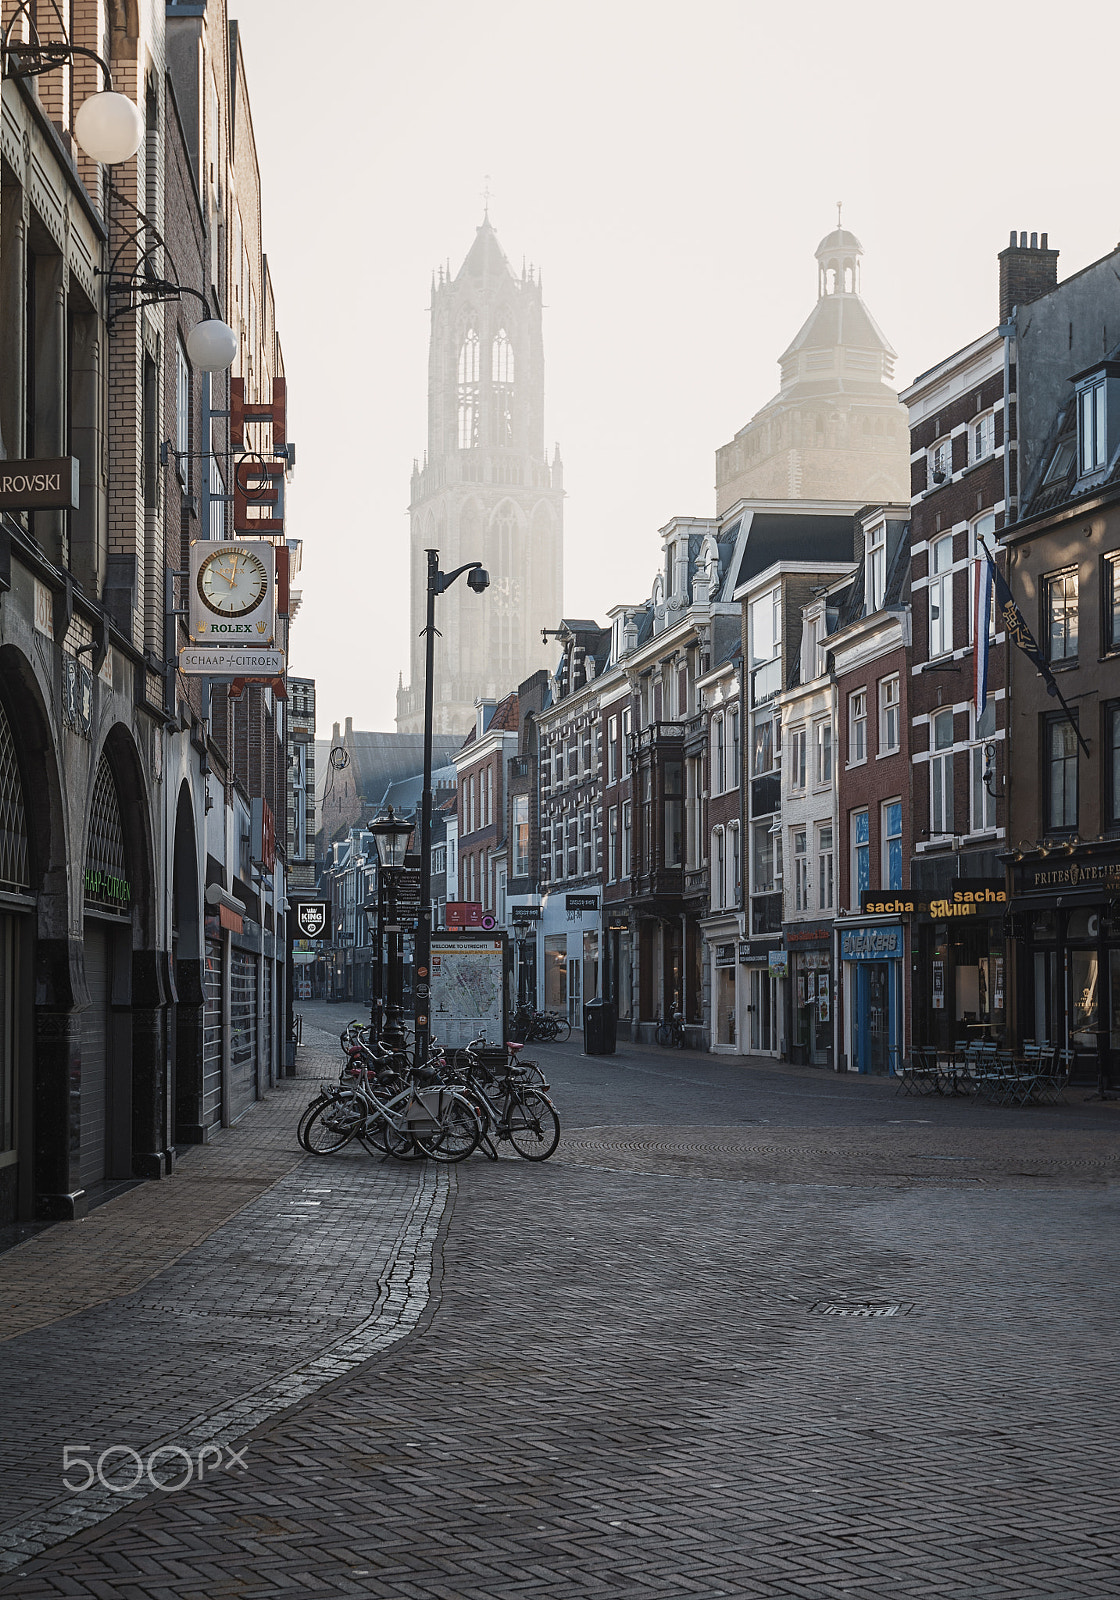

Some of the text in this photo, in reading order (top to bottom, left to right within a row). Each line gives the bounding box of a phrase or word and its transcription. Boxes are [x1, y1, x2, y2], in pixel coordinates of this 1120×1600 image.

[0, 474, 60, 493] ROVSKI
[211, 624, 253, 633] ROLEX
[1034, 869, 1071, 885] FRITES
[954, 888, 1007, 902] sacha
[866, 899, 914, 913] sacha
[843, 933, 898, 953] SNEAKERS
